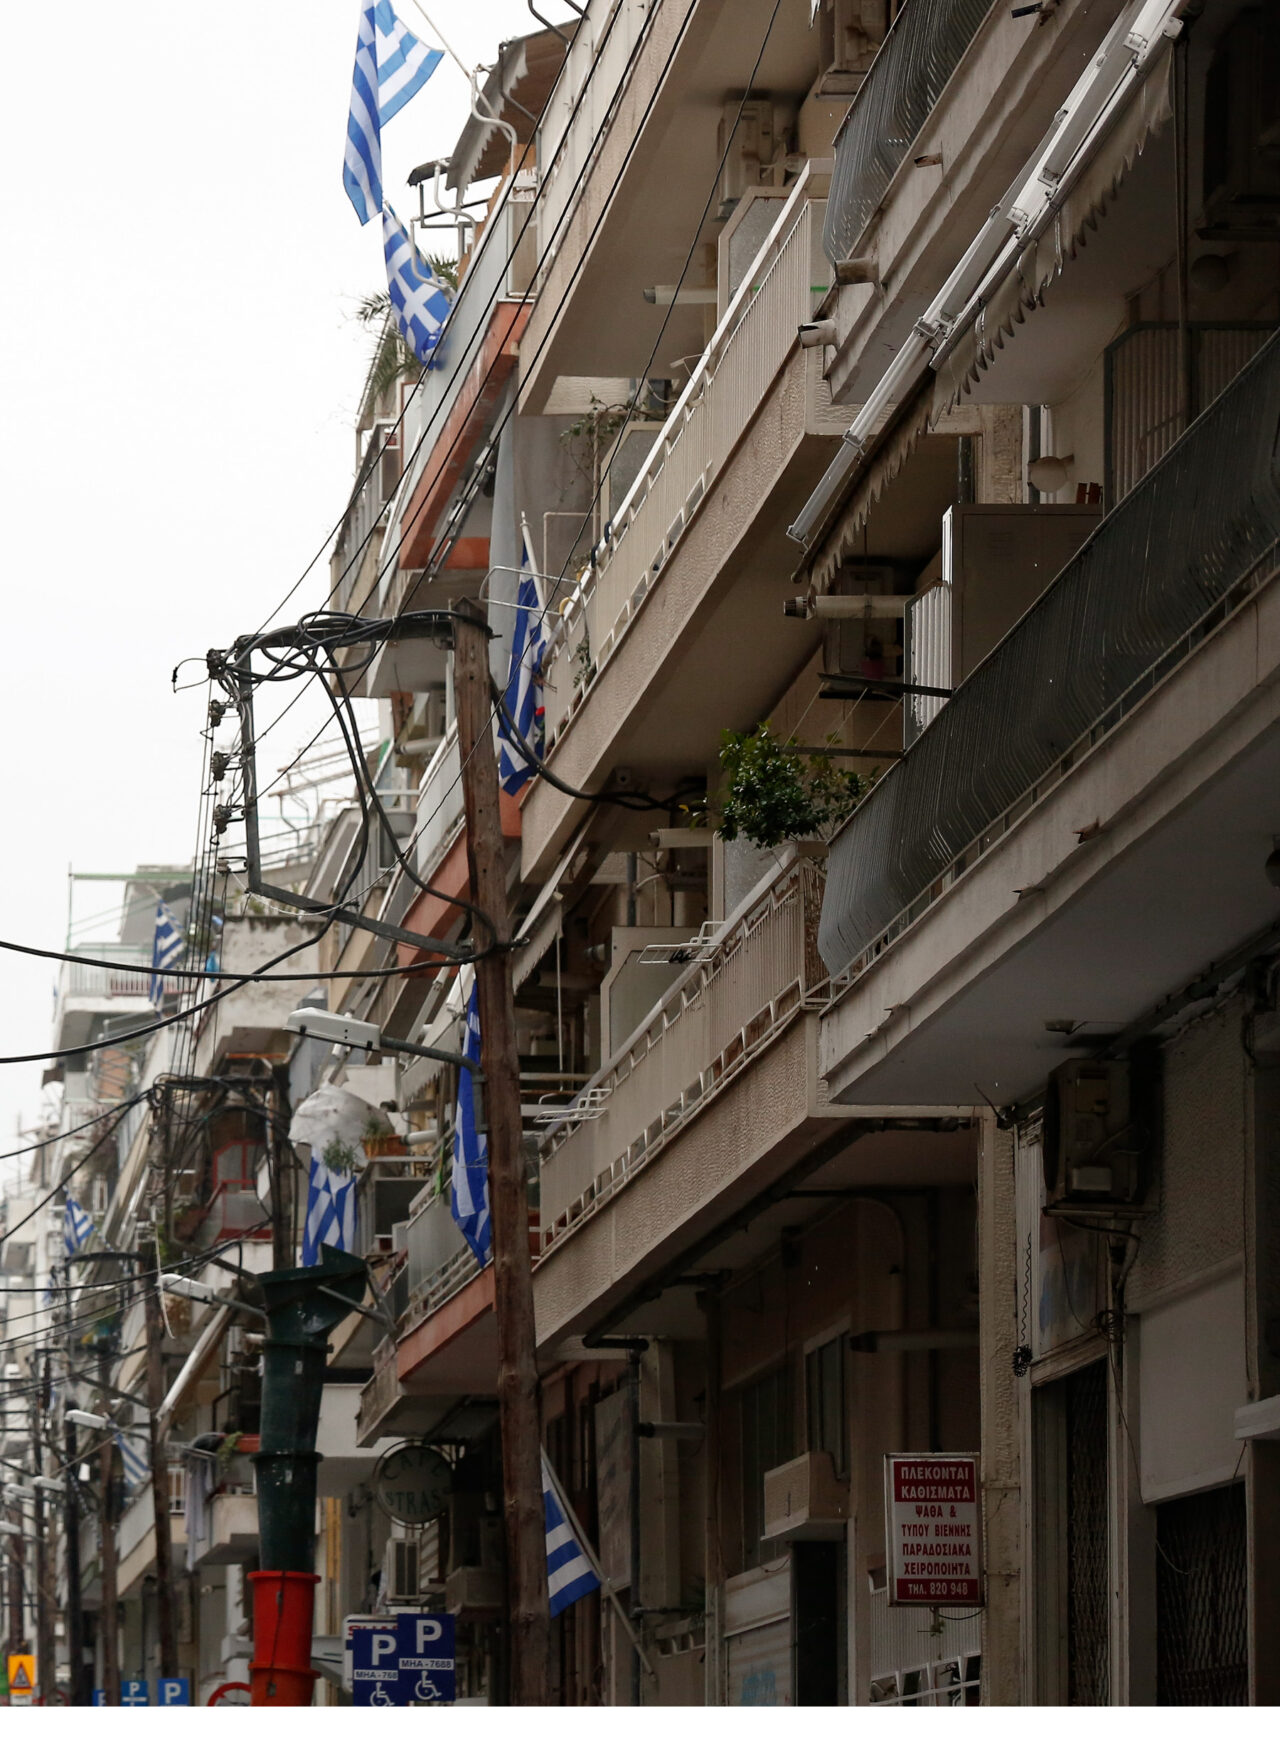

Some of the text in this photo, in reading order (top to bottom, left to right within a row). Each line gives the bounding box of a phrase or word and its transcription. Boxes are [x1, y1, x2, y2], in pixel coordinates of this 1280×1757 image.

[901, 1466, 969, 1480] ΠΛΕΚΟΝΤΑΙ
[901, 1485, 970, 1499] ΚΑΘΙΣΜΑΤΑ
[915, 1504, 957, 1518] ΨΑΘΑ &
[901, 1524, 972, 1537] ΤΥΠΟΥ ΒΙΕΝΝΗΣ
[902, 1543, 972, 1556] ΠΑΡΑΔΟΣΙΑΚΑ
[903, 1562, 971, 1576] ΧΕΙΡΟΠΟΙΗΤΑ
[930, 1582, 948, 1595] 820
[950, 1582, 968, 1596] 948
[416, 1619, 443, 1654] P
[371, 1634, 397, 1666] P
[164, 1682, 181, 1704] P
